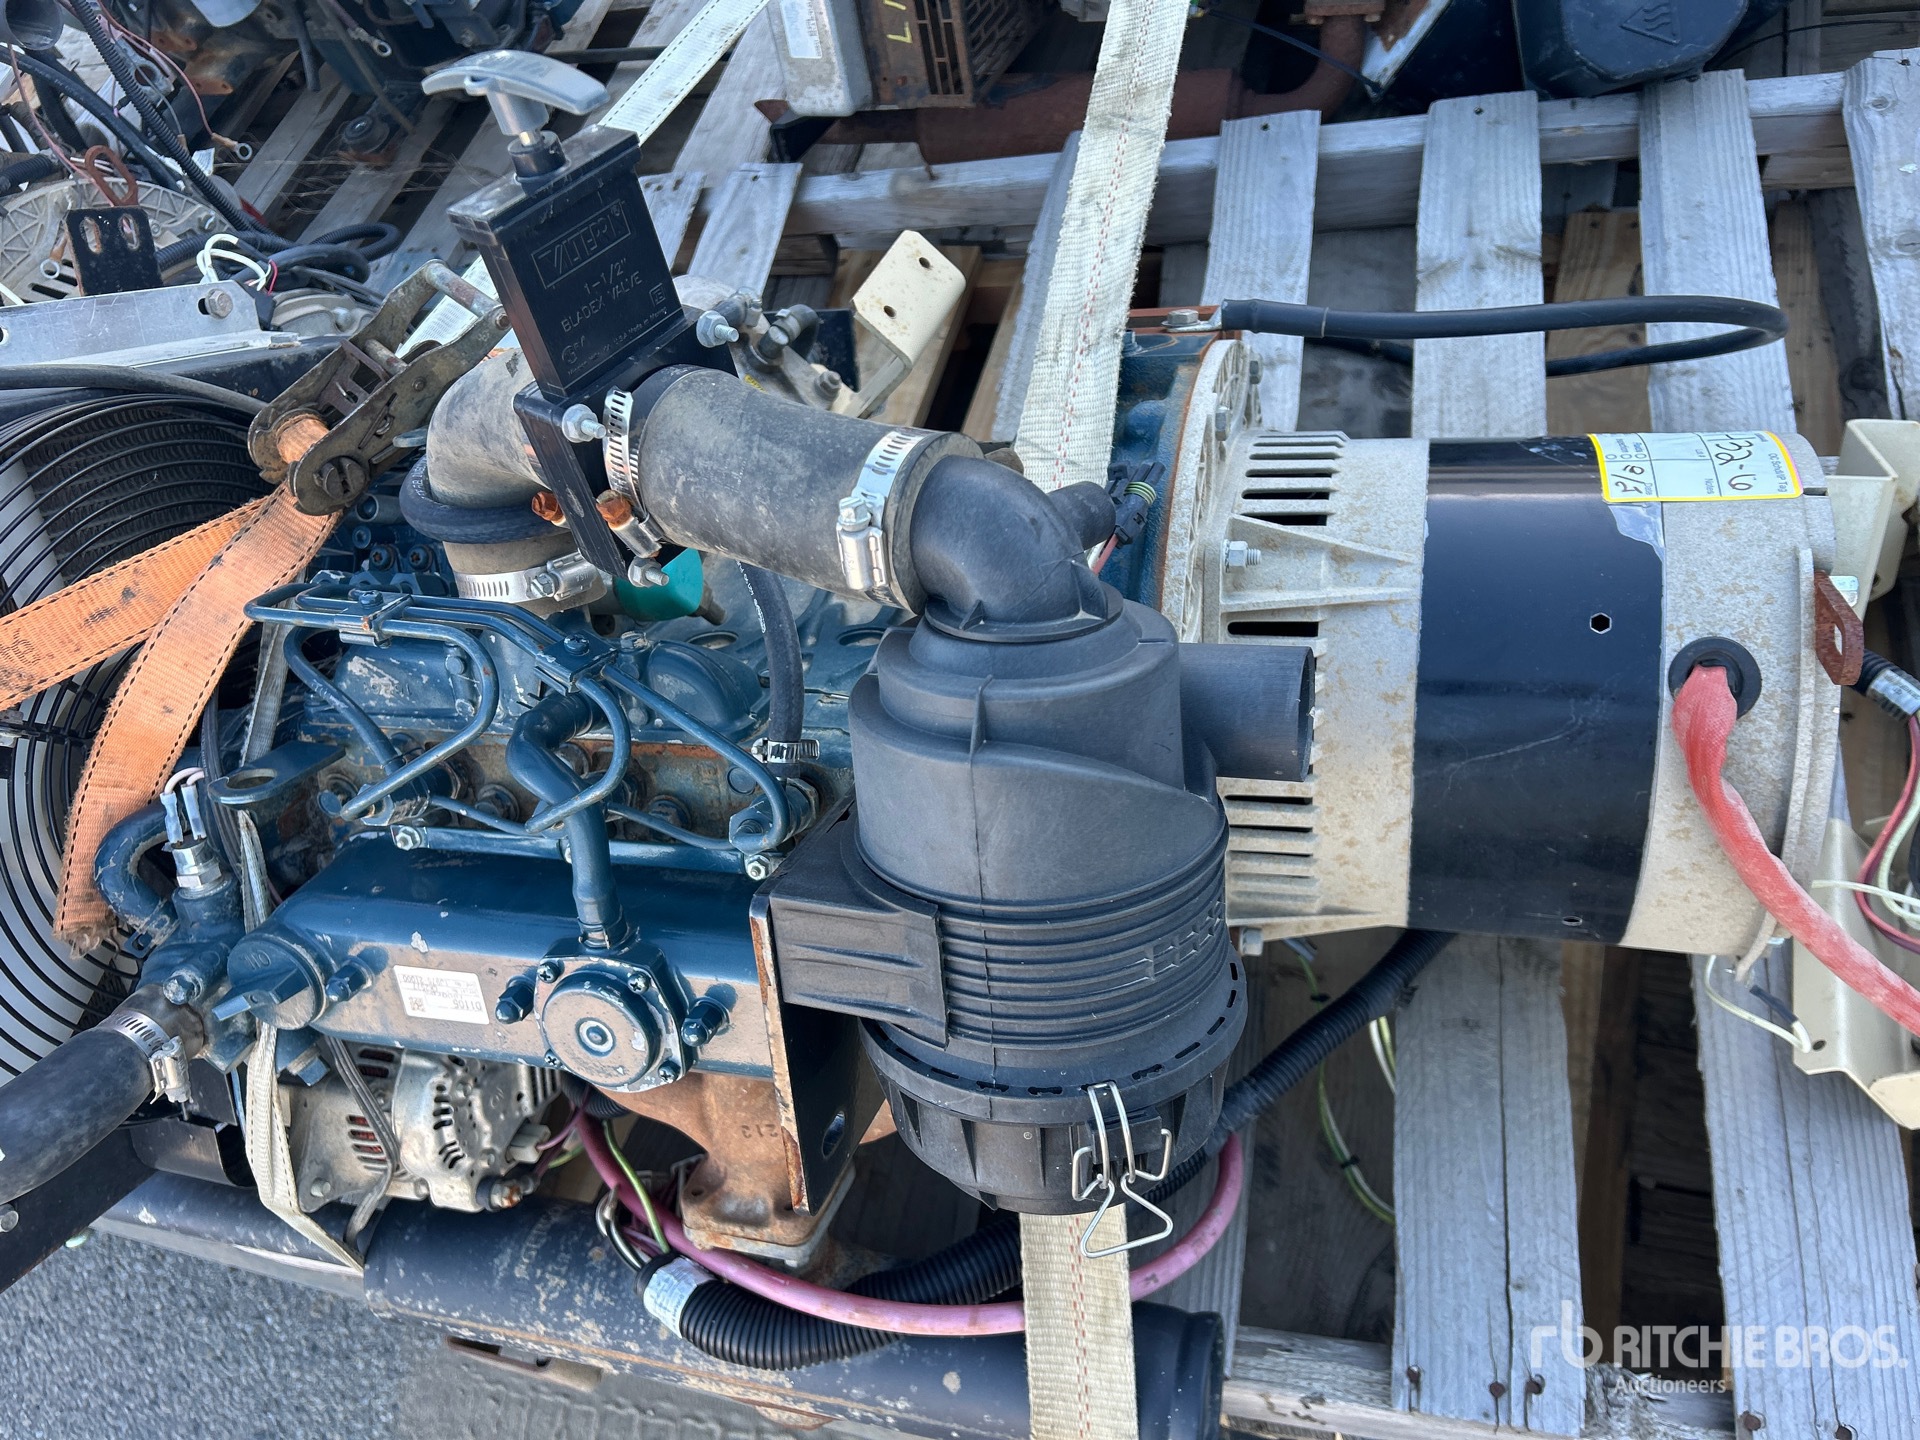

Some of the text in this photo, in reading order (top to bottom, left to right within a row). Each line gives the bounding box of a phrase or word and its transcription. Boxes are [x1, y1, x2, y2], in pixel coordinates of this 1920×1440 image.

[560, 296, 606, 333] BLADEX
[607, 270, 643, 301] VALVE
[1704, 478, 1716, 495] Notes
[1777, 481, 1789, 493] Tag
